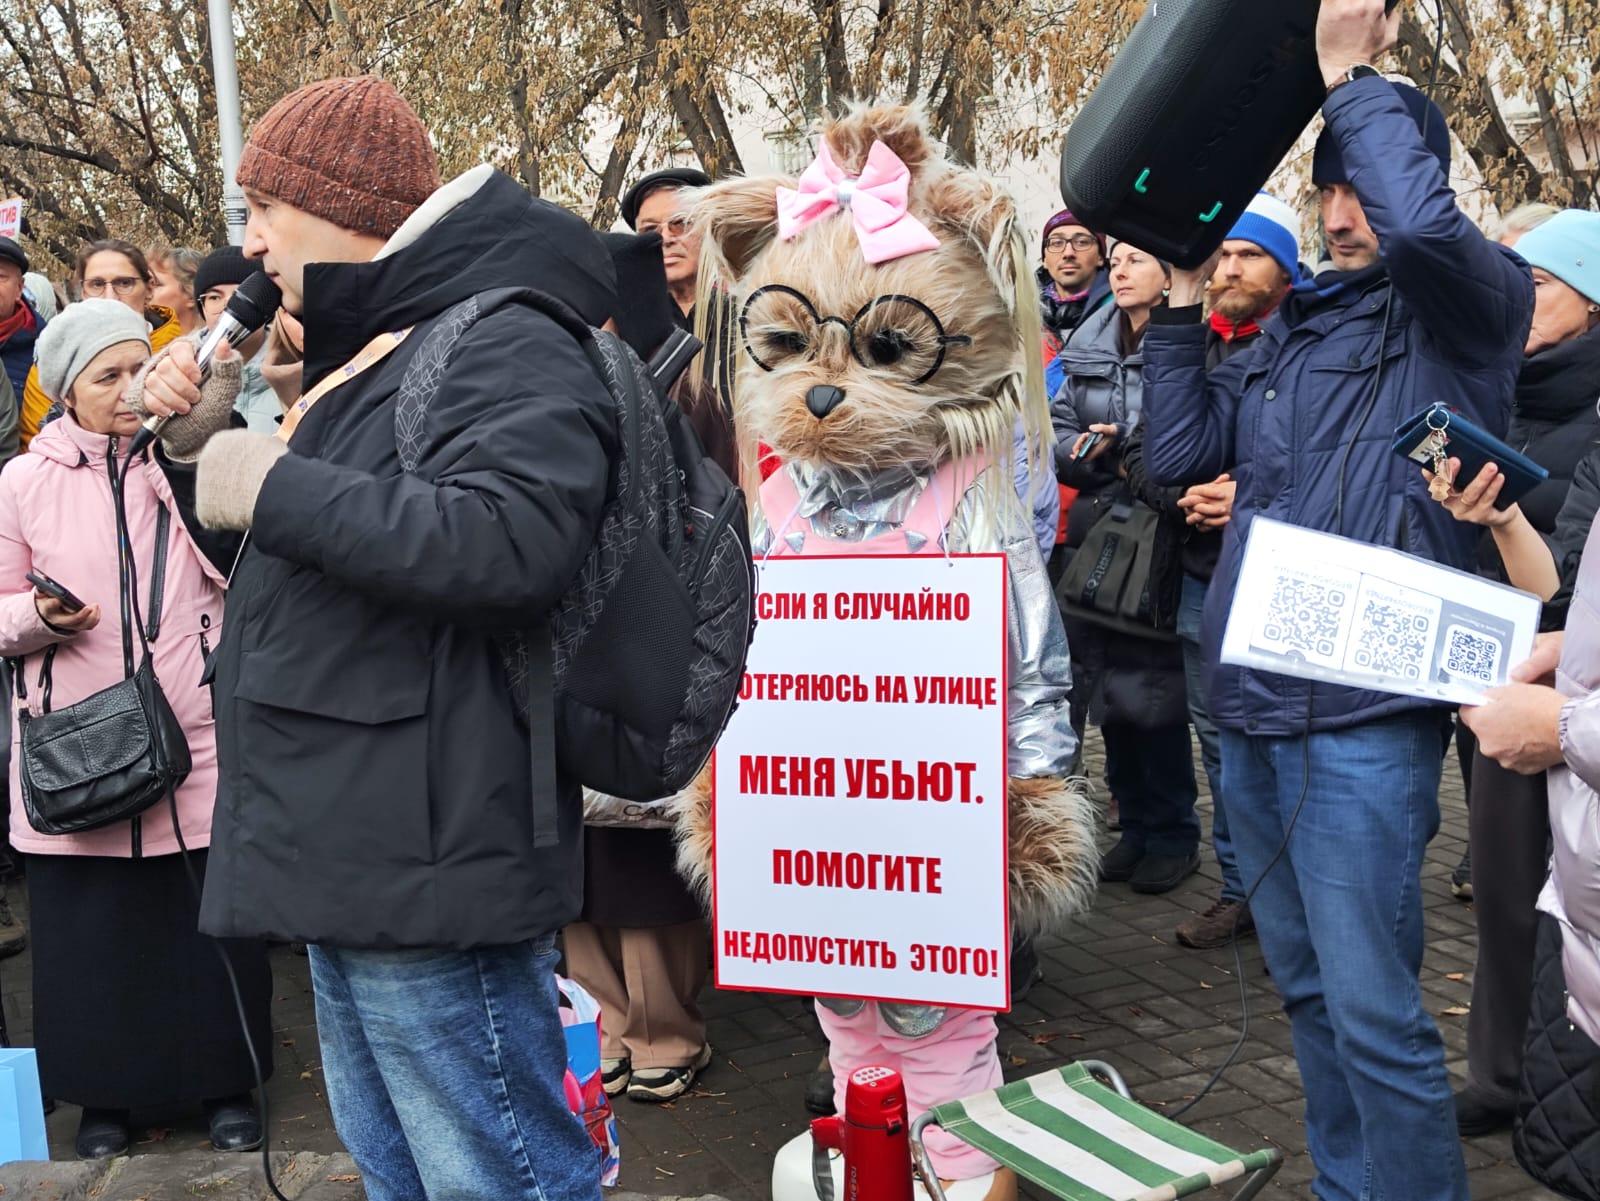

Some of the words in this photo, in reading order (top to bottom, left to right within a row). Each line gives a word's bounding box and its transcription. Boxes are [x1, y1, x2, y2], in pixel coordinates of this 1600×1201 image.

[753, 592, 807, 620] СЛИ
[813, 593, 828, 620] Я
[834, 587, 971, 621] СЛУЧАЙНО
[738, 673, 868, 702] ОТЕРЯЮСЬ
[875, 675, 907, 703] НА
[914, 676, 998, 710] УЛИЦЕ
[739, 754, 836, 798] МЕНЯ
[845, 757, 984, 804] УБЬЮТ.
[772, 848, 942, 895] ПОМОГИТЕ
[723, 929, 897, 970] НЕДОПУСТИТЬ
[910, 943, 999, 978] ЭТОГО!
